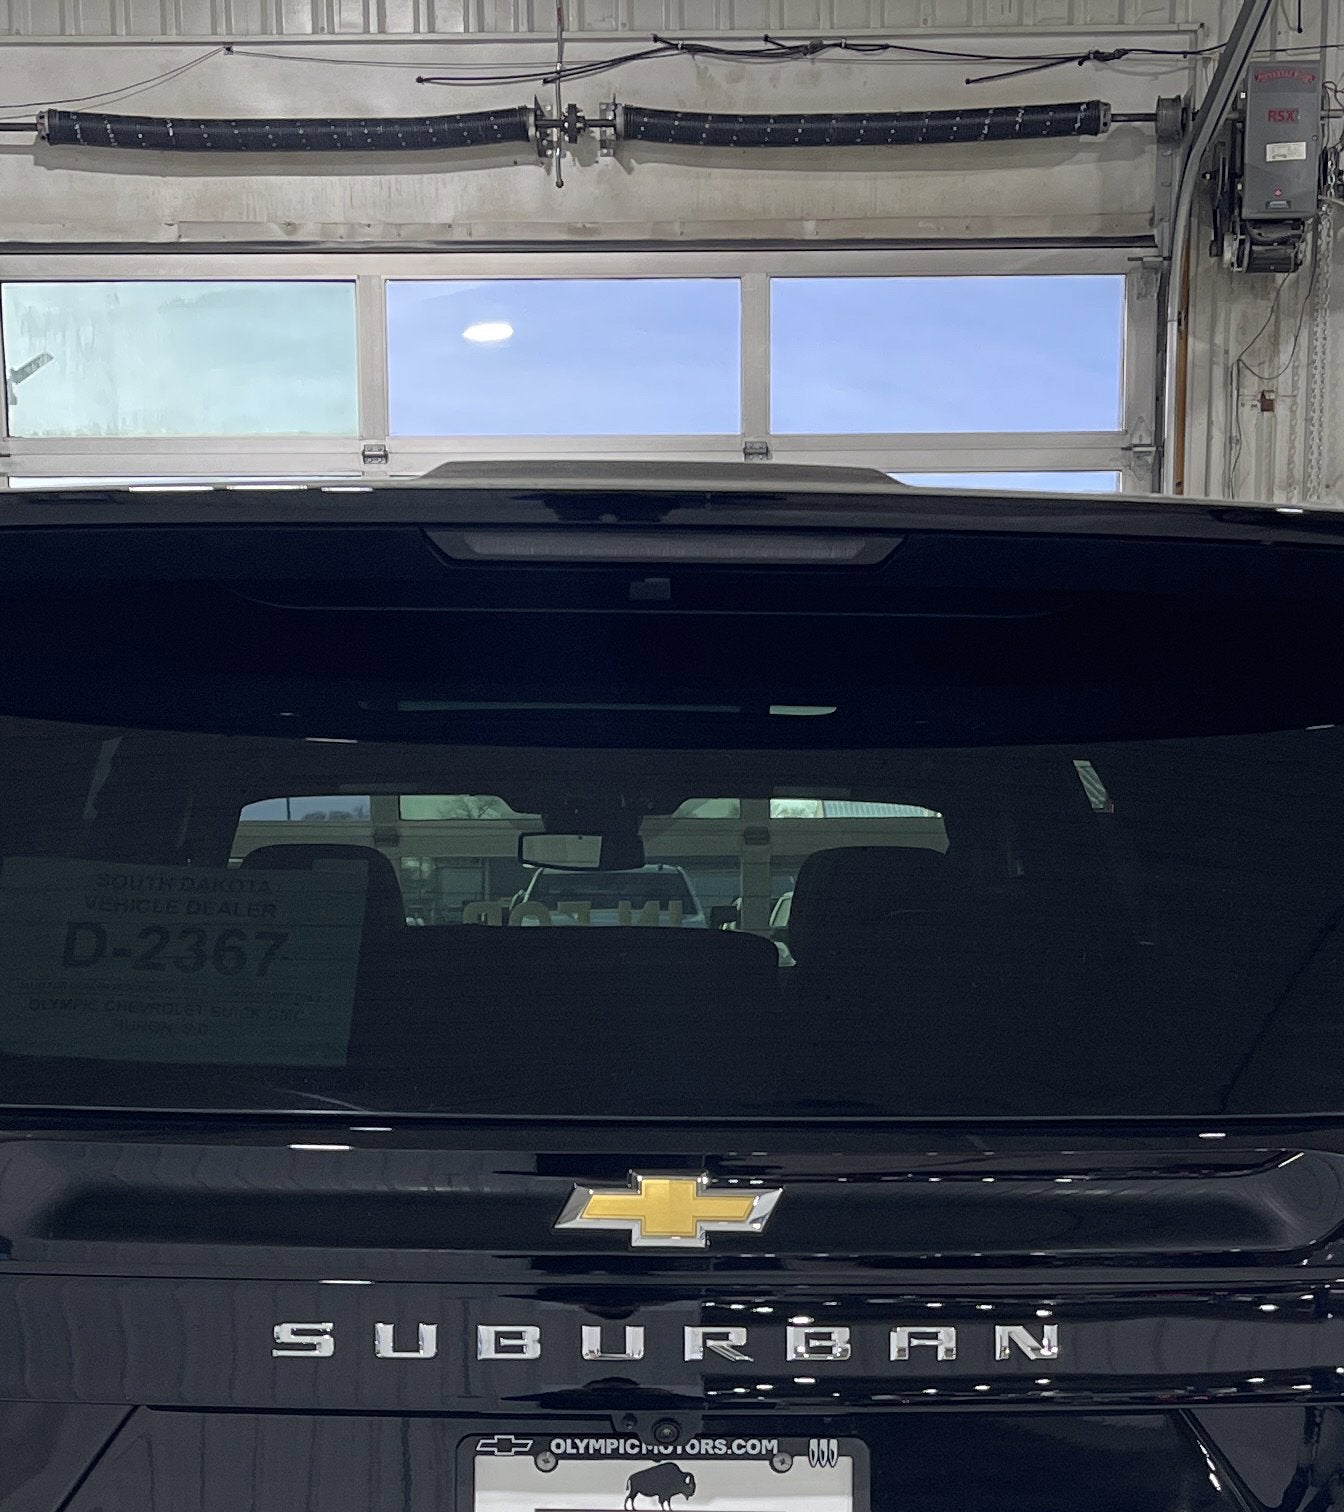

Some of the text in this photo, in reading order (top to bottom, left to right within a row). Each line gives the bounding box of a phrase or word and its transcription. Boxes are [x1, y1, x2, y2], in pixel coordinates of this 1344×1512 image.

[96, 873, 272, 894] SOUTH DAKOTA
[84, 894, 277, 919] VEHICLE DEALER
[62, 921, 289, 978] D-2367
[271, 1322, 1060, 1362] SUBURBAN
